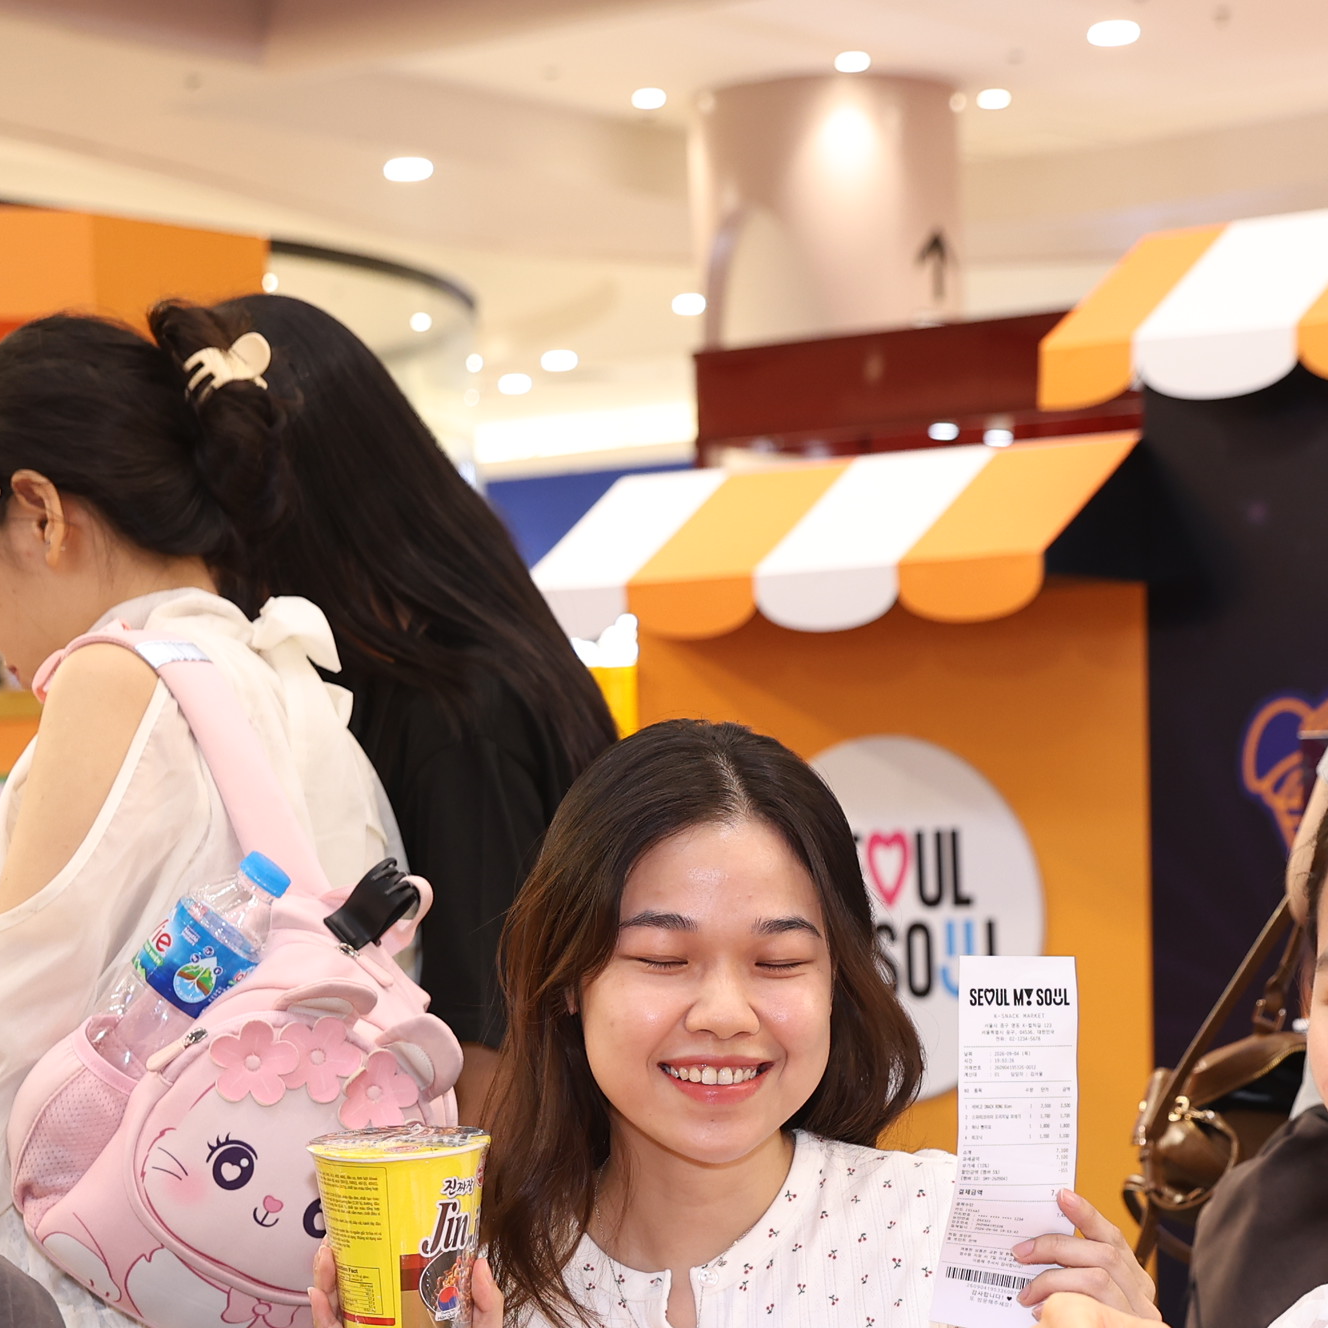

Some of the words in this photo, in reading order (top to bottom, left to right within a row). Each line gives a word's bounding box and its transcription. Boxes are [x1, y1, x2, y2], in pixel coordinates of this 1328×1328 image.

[443, 1178, 474, 1195] 진짜장
[421, 1202, 469, 1255] Jin
[971, 1290, 1004, 1299] 감사합니다!
